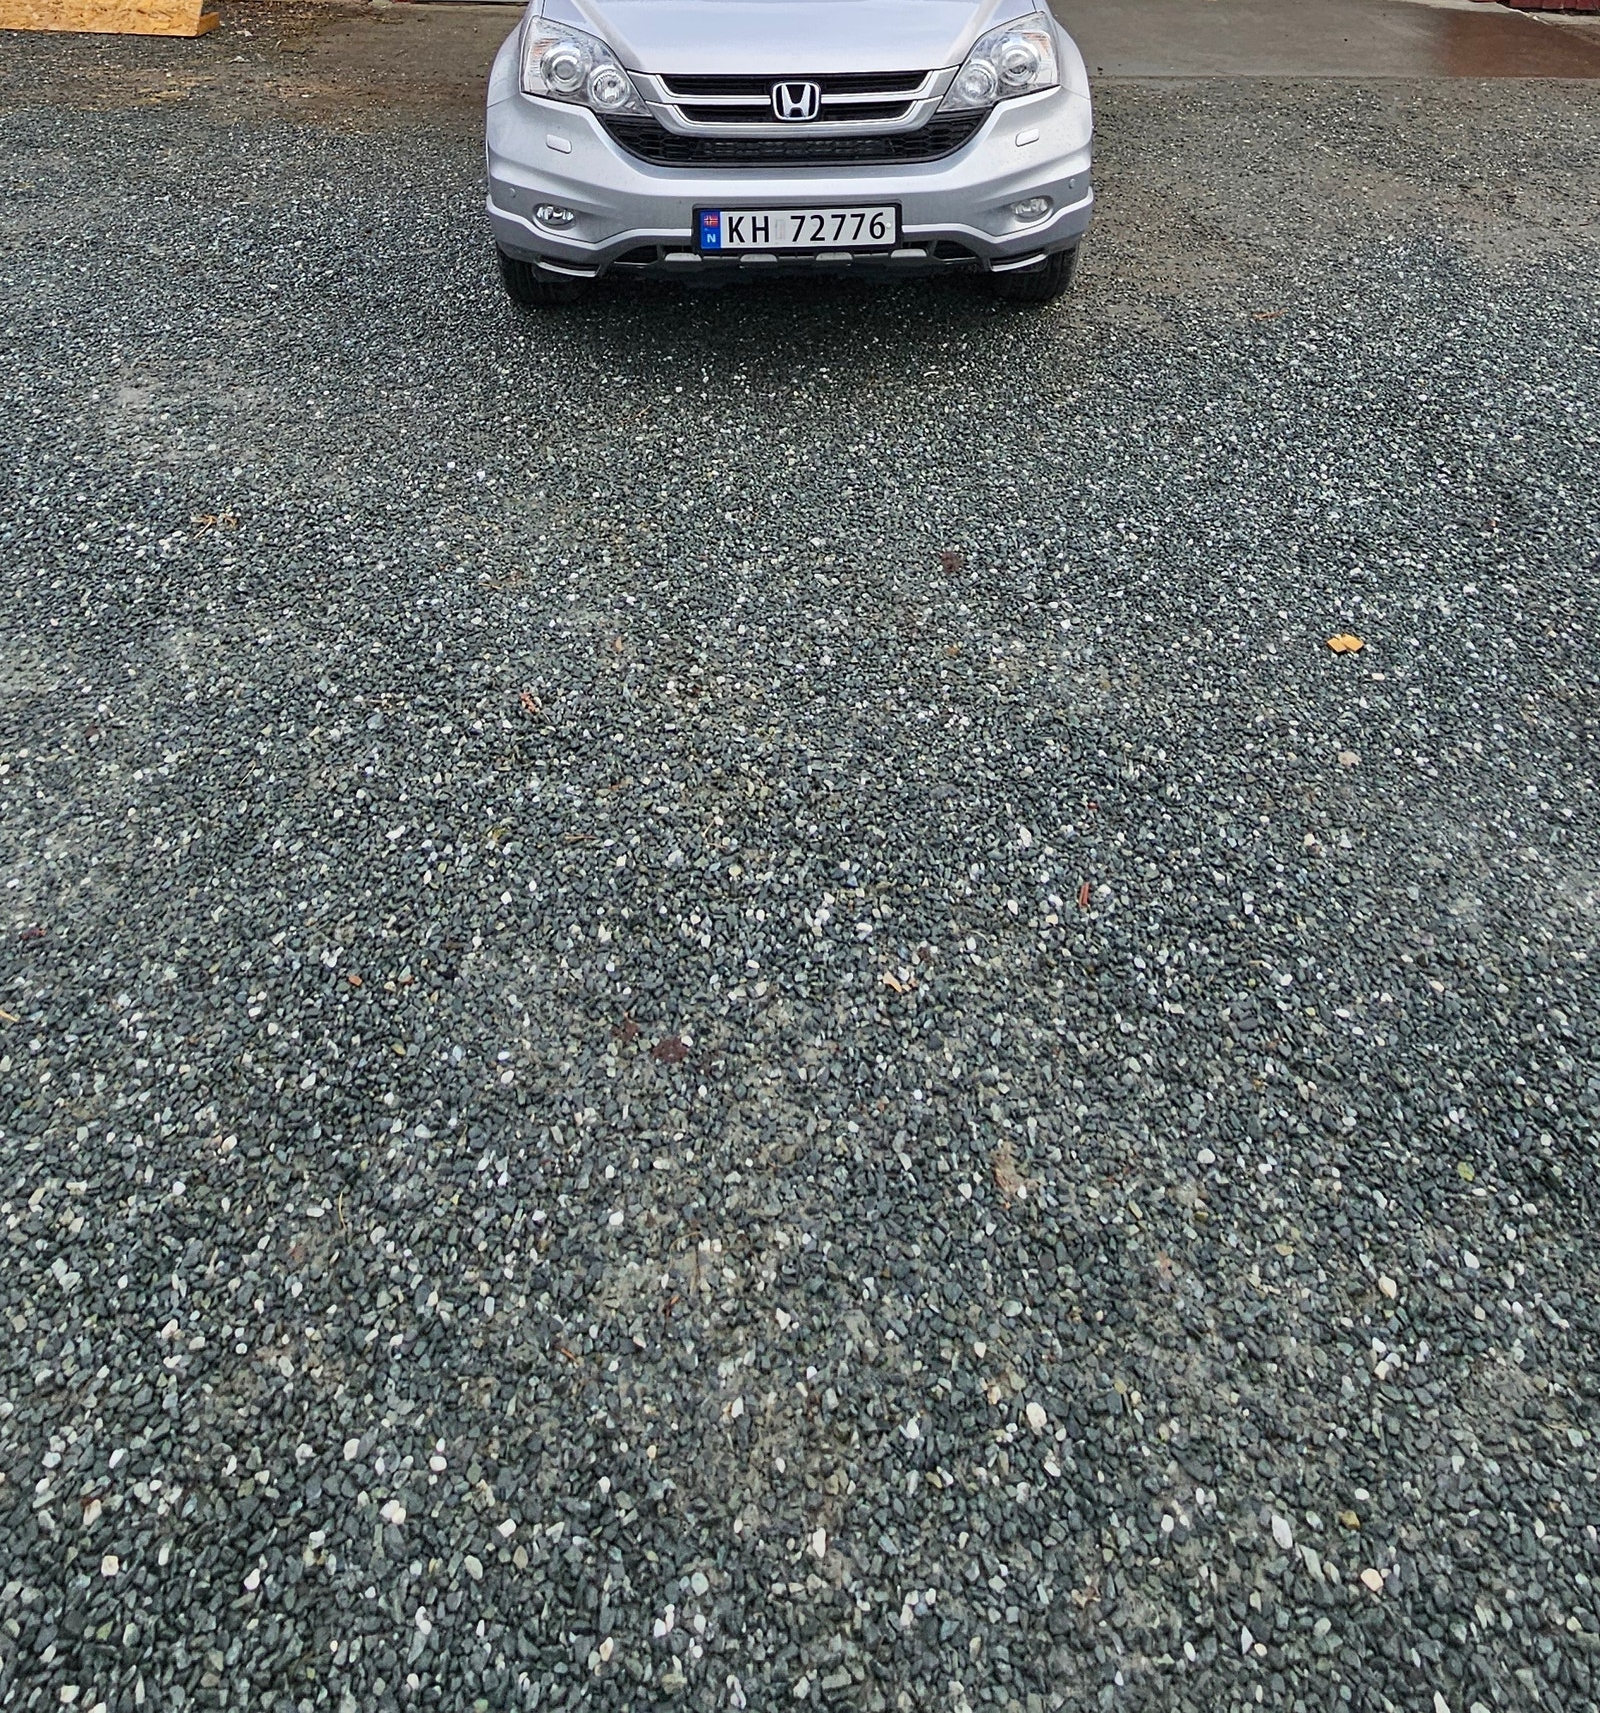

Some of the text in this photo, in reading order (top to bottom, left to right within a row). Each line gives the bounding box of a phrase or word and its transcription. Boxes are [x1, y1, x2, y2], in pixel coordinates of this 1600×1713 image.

[728, 212, 886, 243] KH 72776
[706, 233, 716, 243] N
